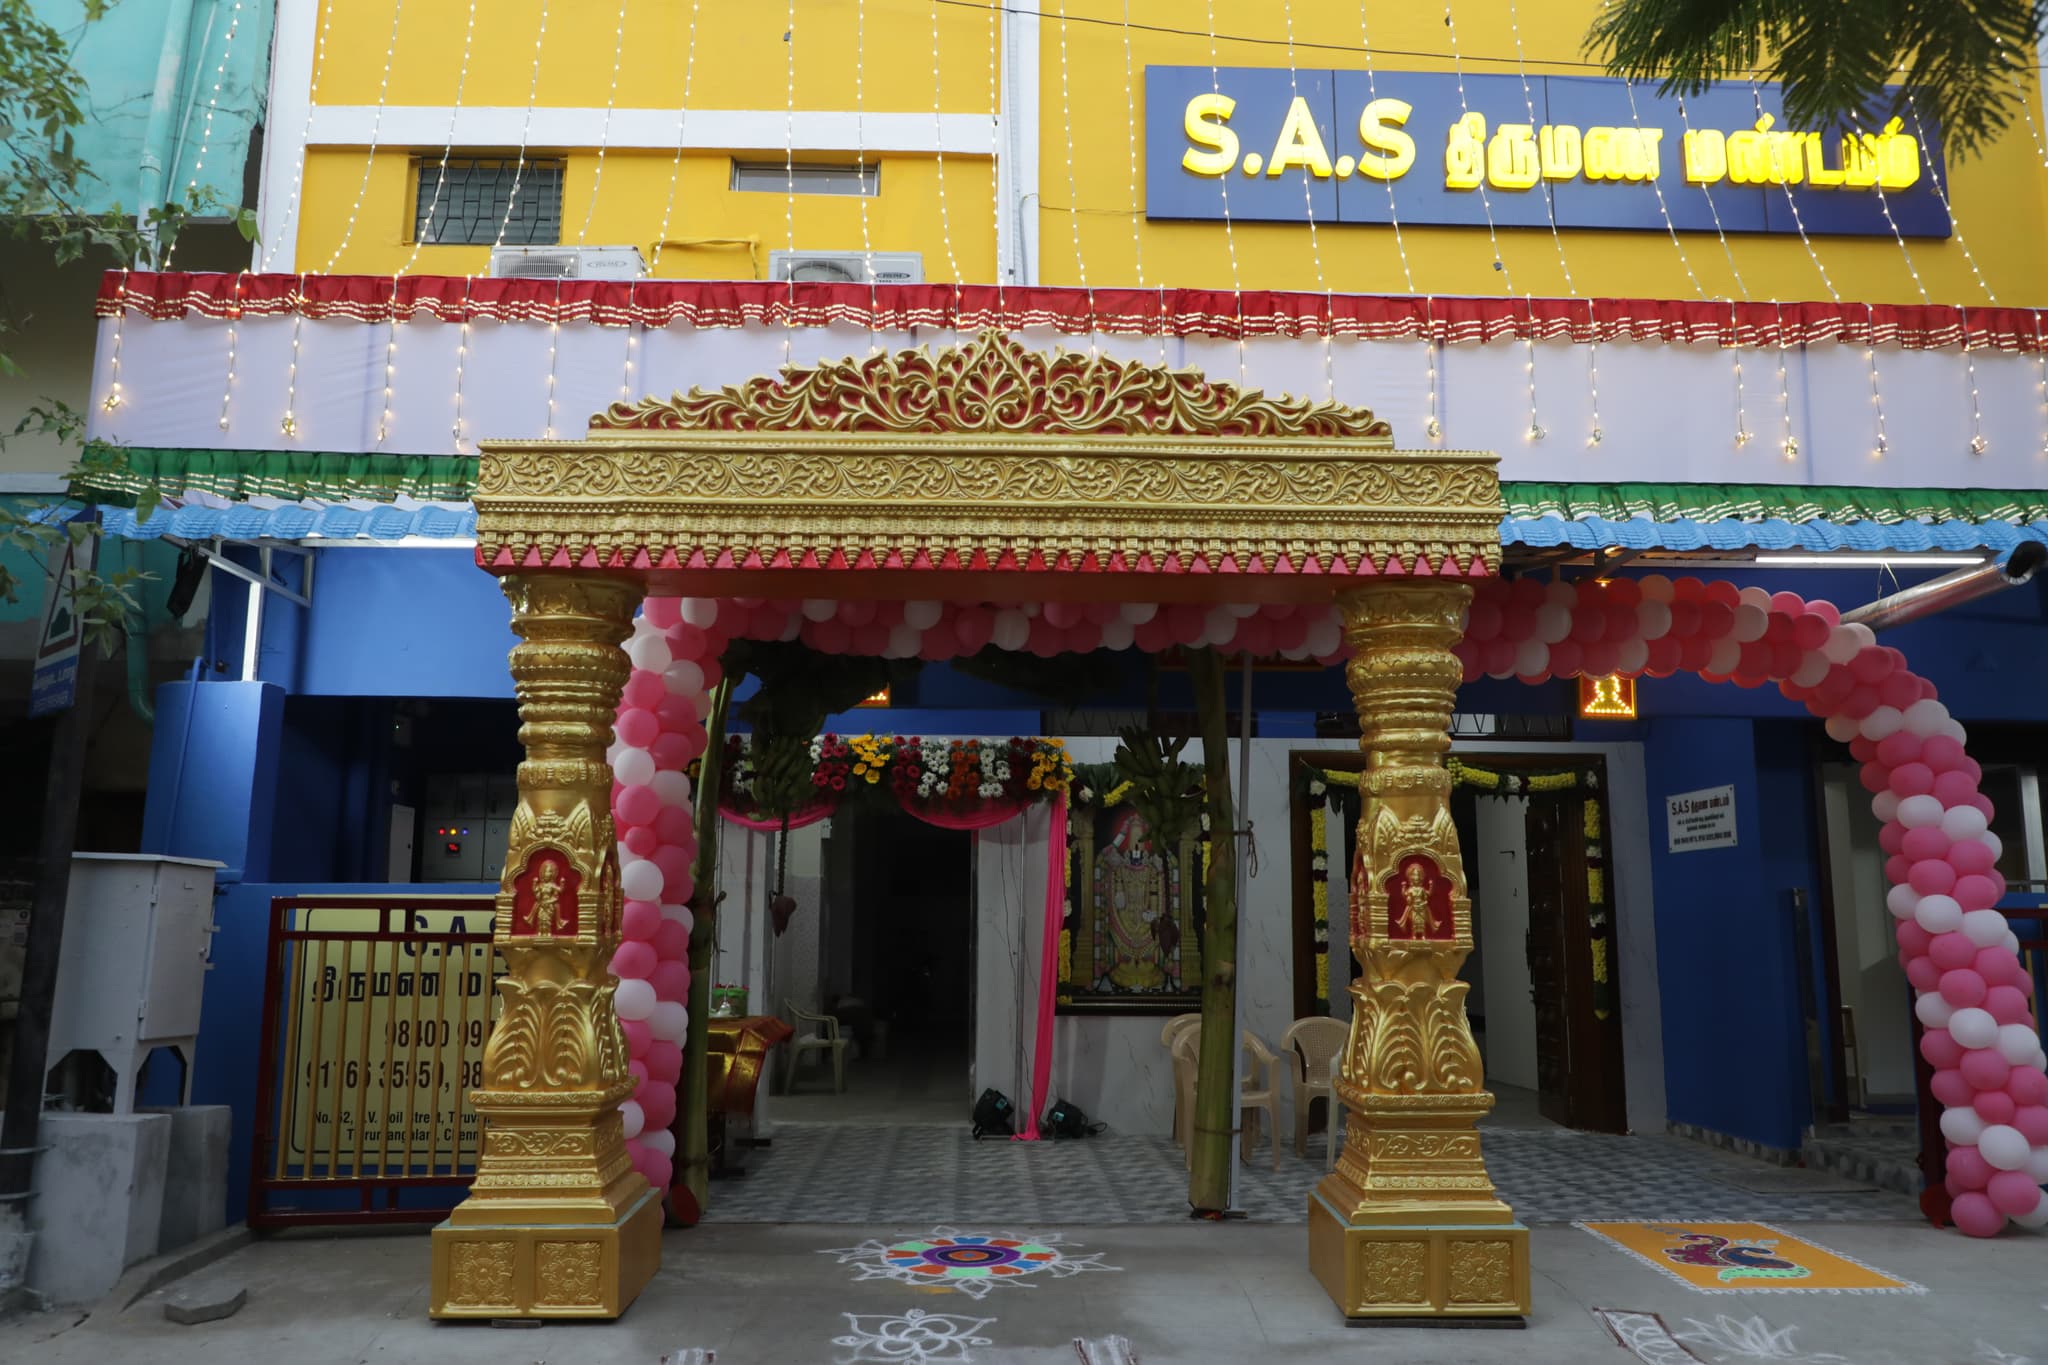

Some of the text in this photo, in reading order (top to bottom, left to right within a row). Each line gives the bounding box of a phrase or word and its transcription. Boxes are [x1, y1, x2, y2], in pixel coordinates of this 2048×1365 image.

[1182, 93, 1920, 189] S.A.S திருமண மண்டபம்
